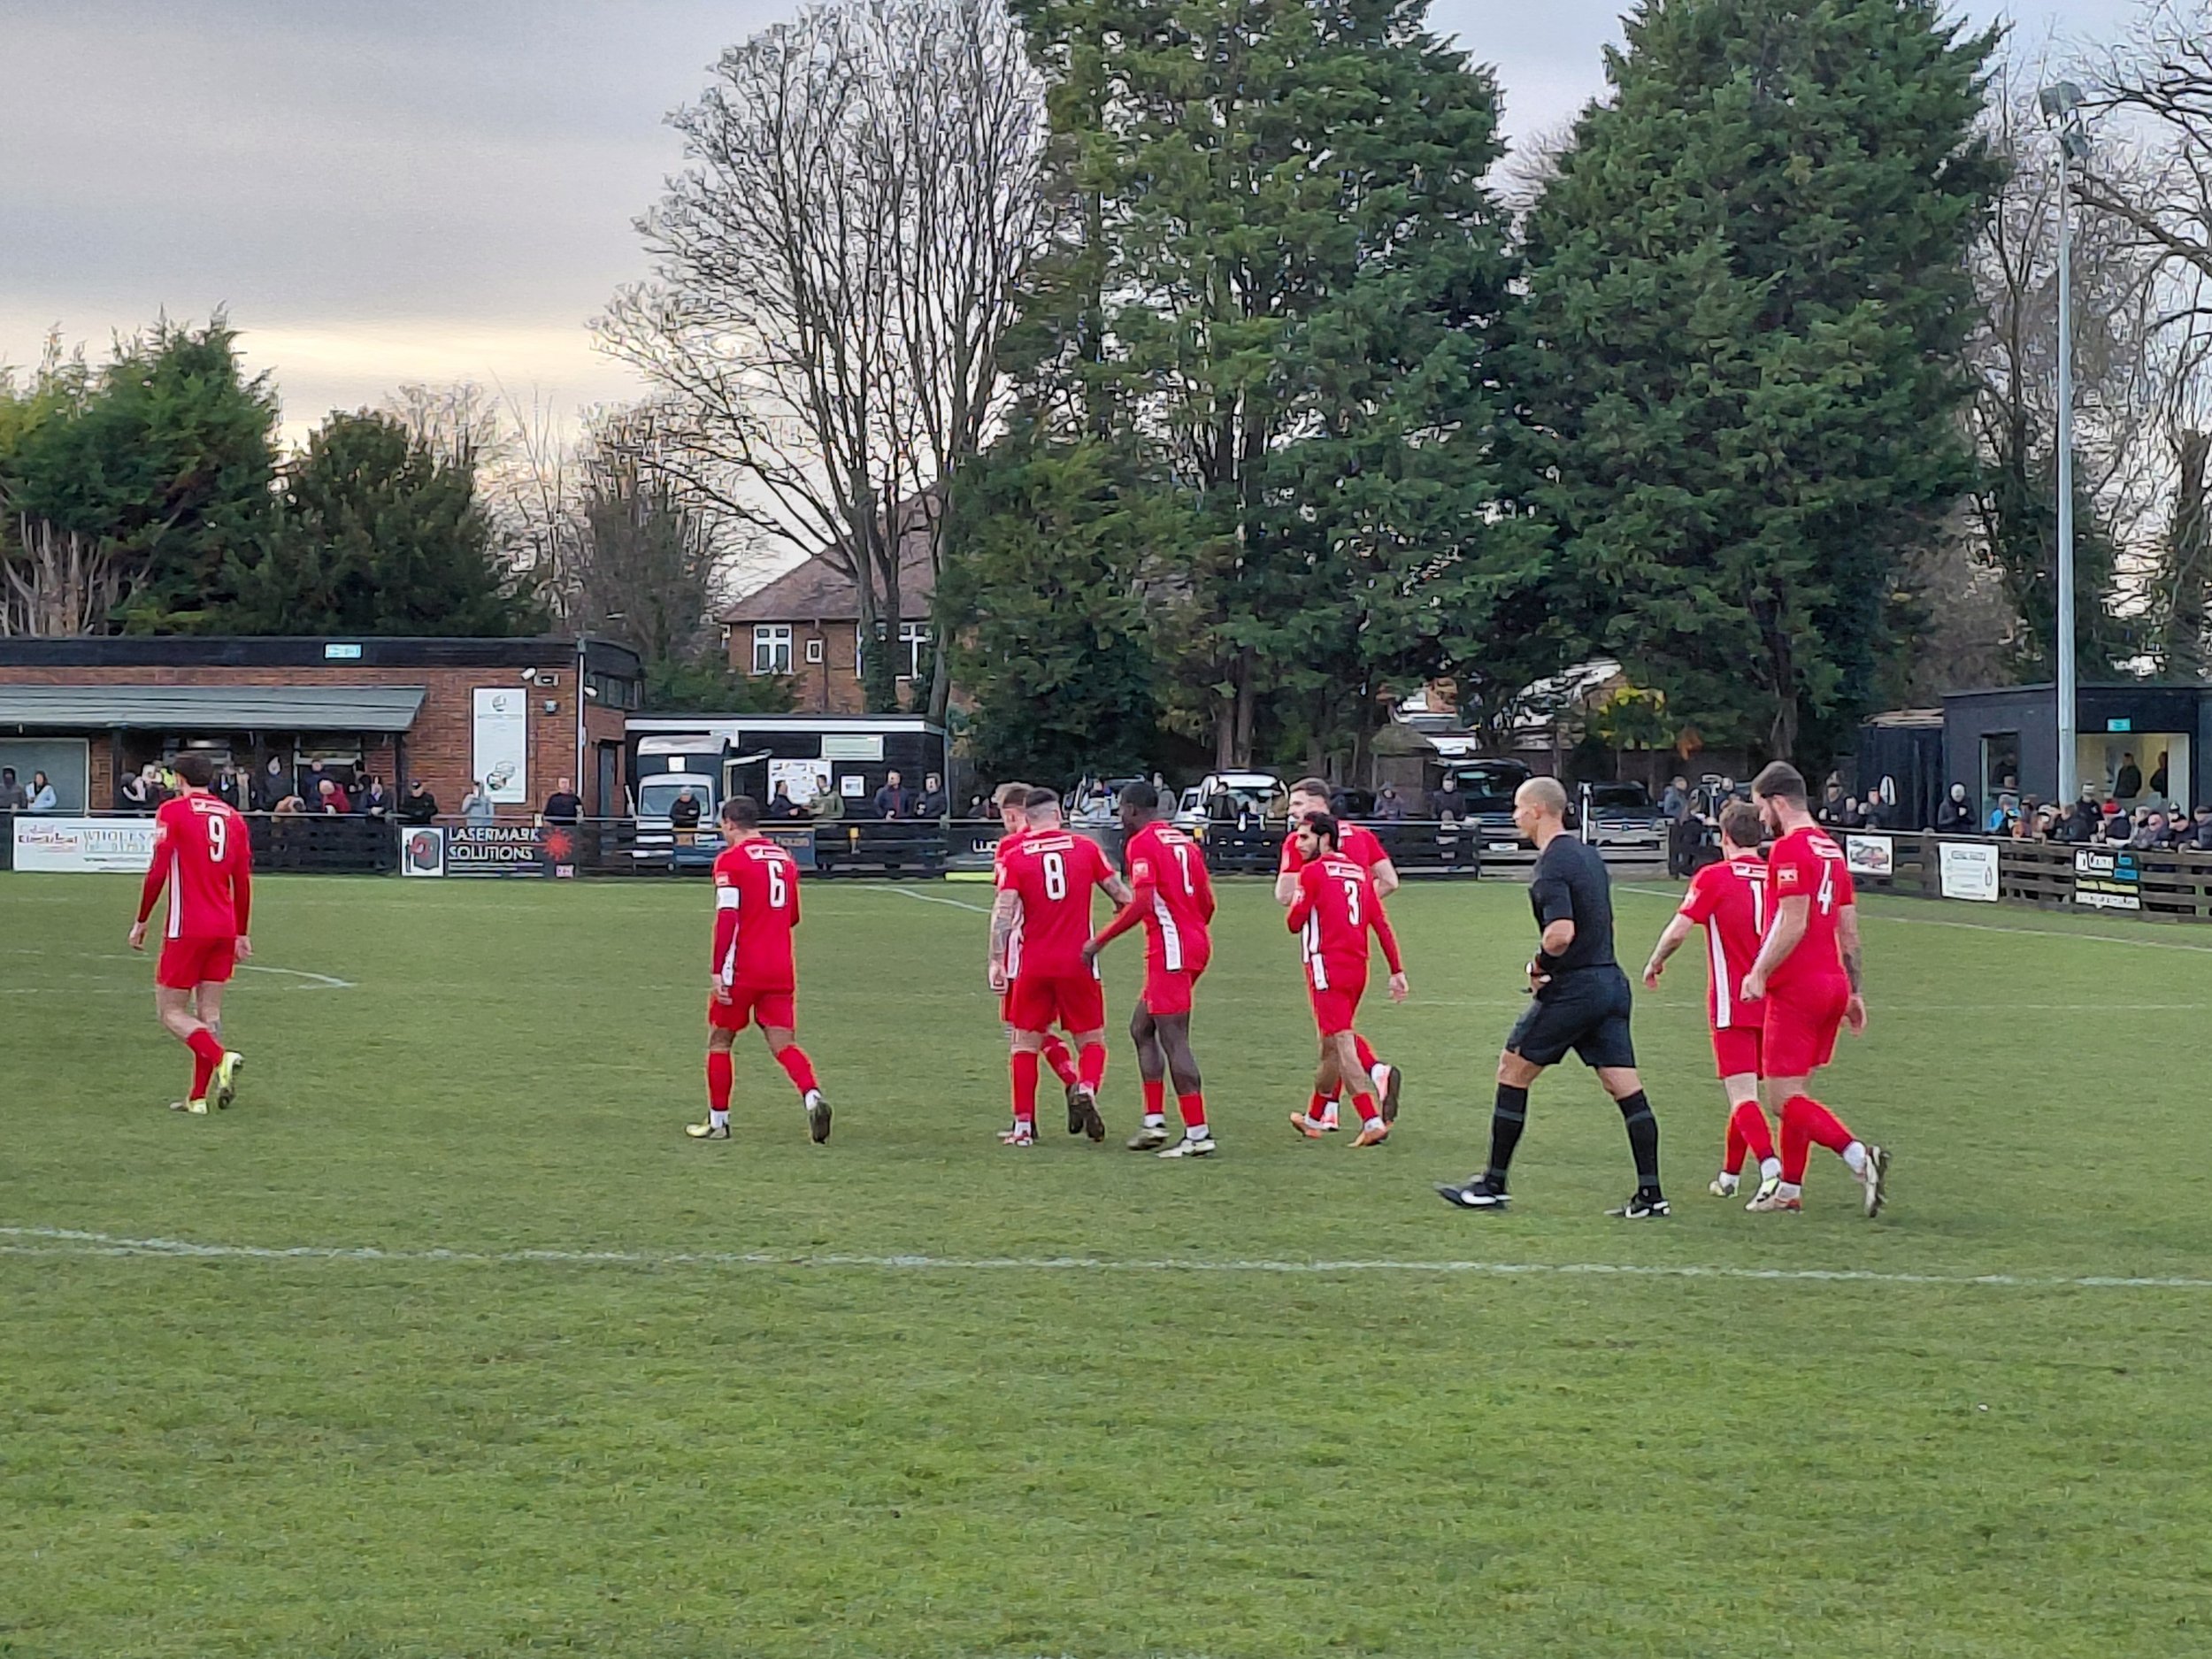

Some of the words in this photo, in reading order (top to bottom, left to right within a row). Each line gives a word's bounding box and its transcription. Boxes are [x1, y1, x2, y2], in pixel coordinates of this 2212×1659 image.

[208, 815, 226, 862] 9
[448, 846, 534, 860] SOLUTIONS
[449, 826, 540, 841] LASERMARK
[768, 860, 787, 908] 6
[1043, 852, 1066, 901] 8
[1817, 859, 1834, 915] 4
[1344, 879, 1360, 926] 3
